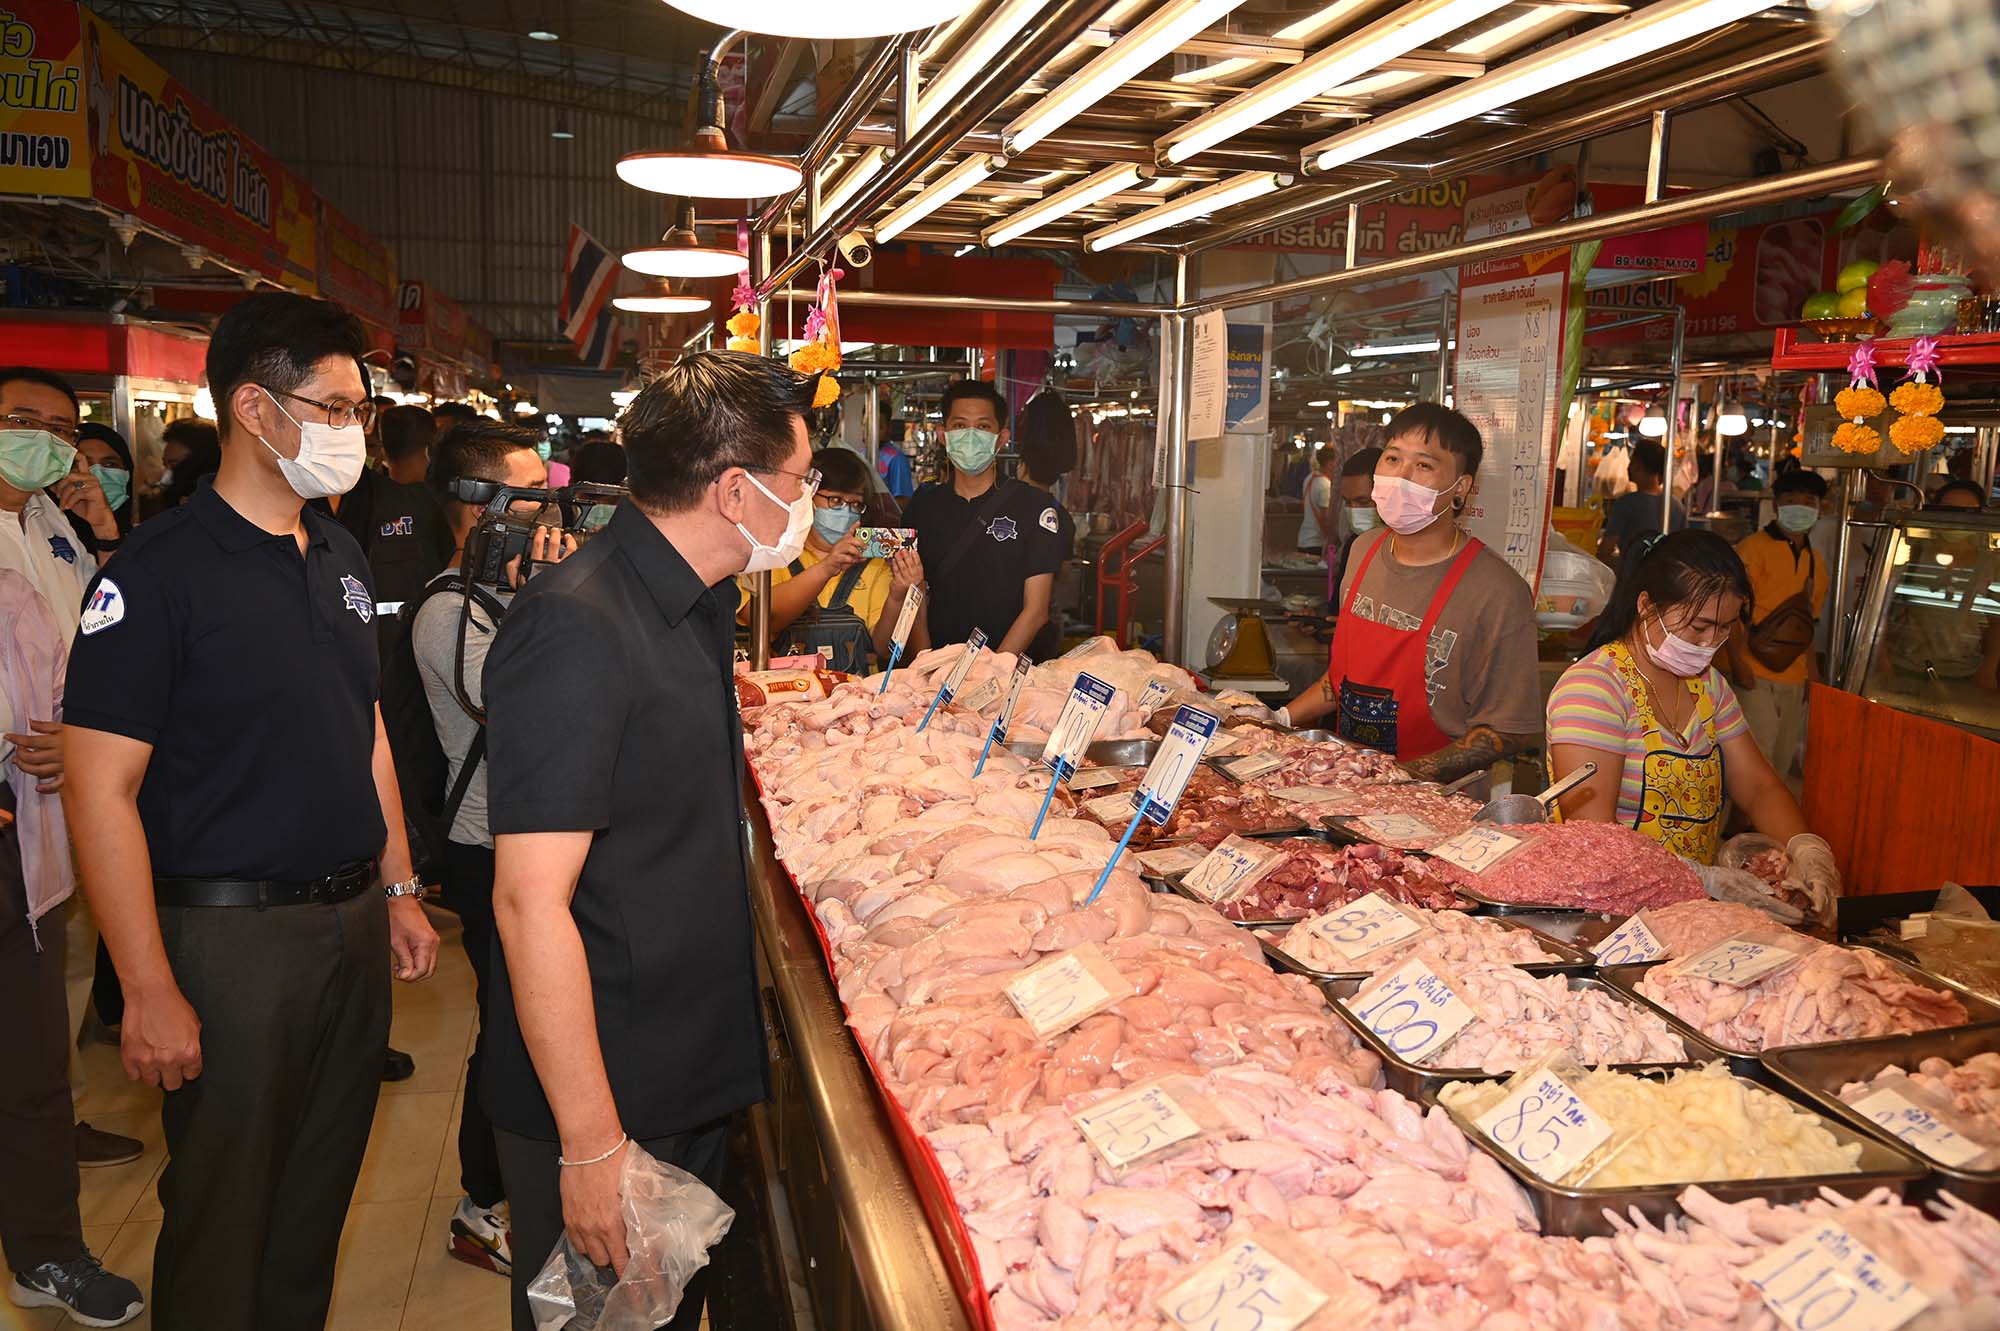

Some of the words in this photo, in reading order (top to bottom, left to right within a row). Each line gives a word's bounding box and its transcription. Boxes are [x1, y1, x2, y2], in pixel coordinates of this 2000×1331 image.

[0, 60, 80, 112] นไก่
[1322, 910, 1381, 943] 85
[1368, 983, 1438, 1053] 100
[1492, 1096, 1569, 1162] 85
[1751, 1249, 1858, 1331] 110
